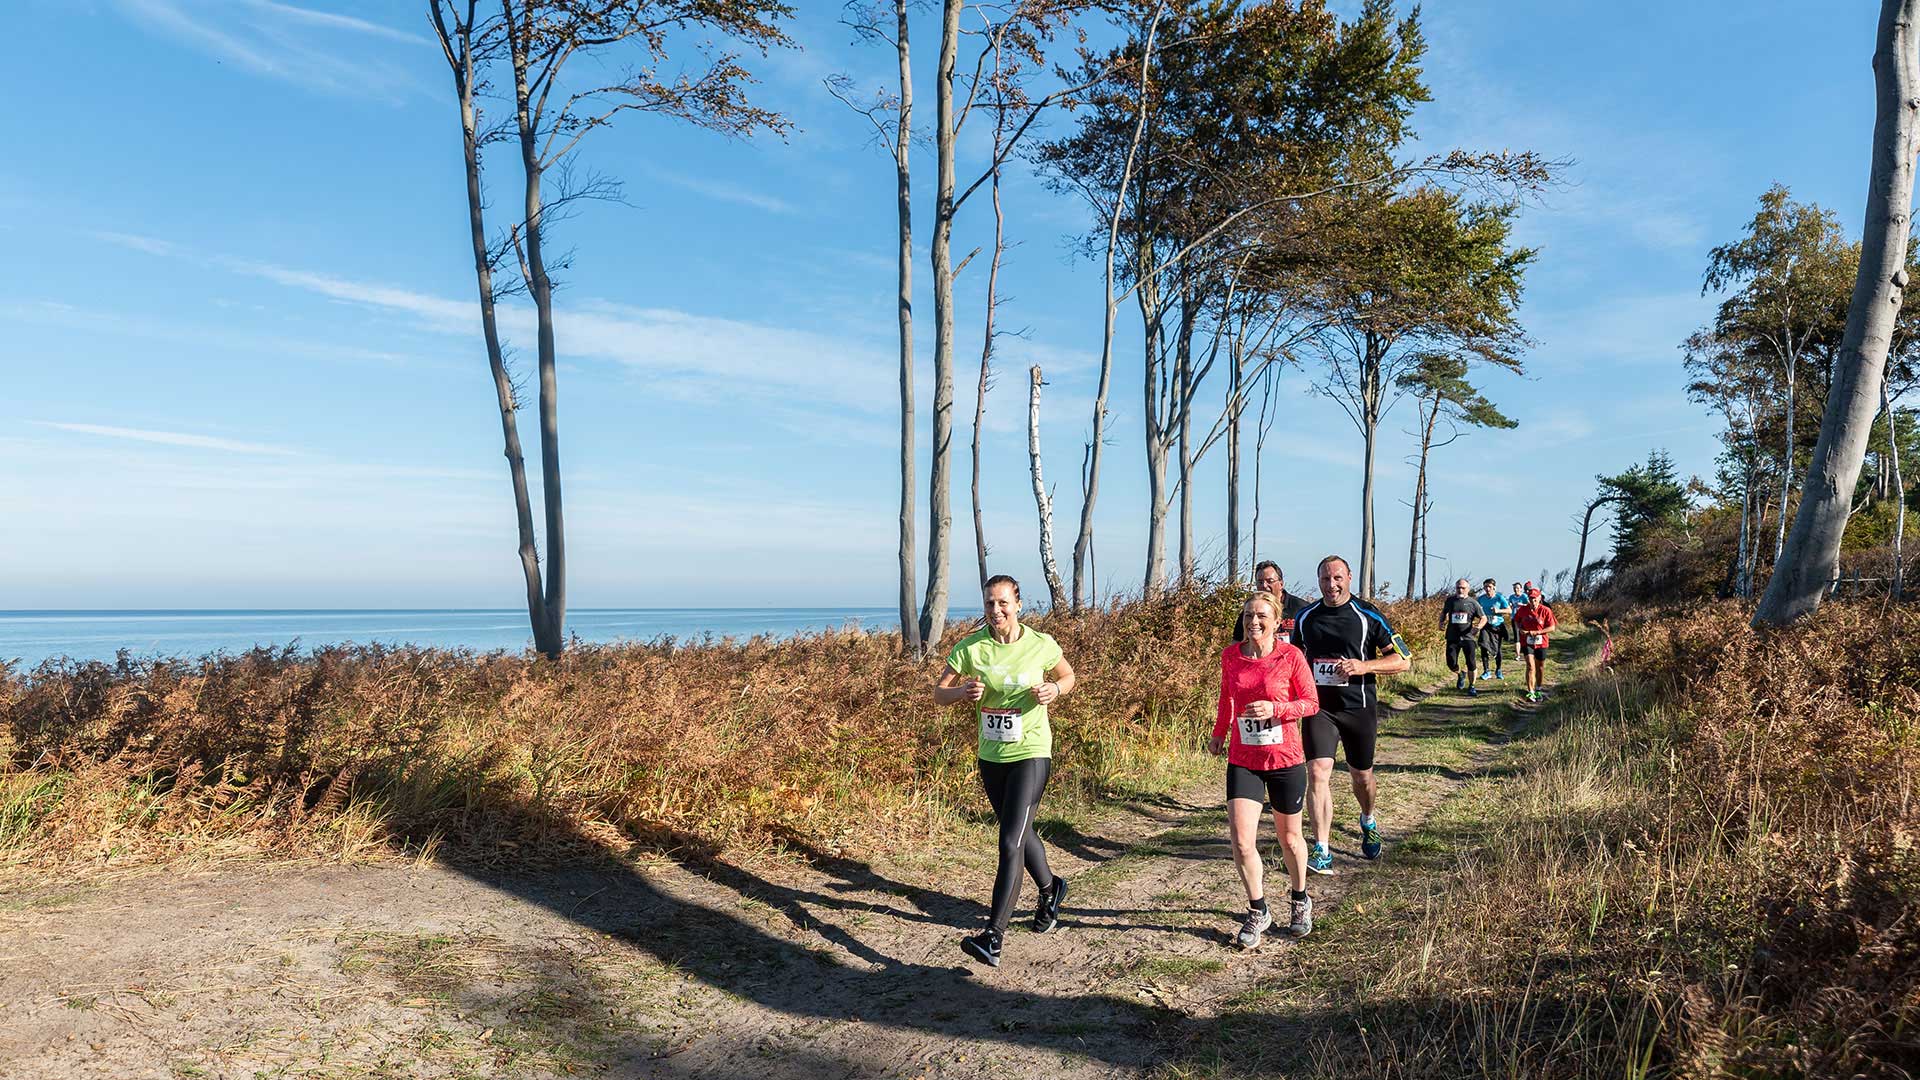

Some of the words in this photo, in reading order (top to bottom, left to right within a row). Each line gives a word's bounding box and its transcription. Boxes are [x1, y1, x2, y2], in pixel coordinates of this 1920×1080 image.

[1319, 664, 1336, 675] 44
[987, 714, 1013, 729] 375
[1244, 719, 1272, 732] 314
